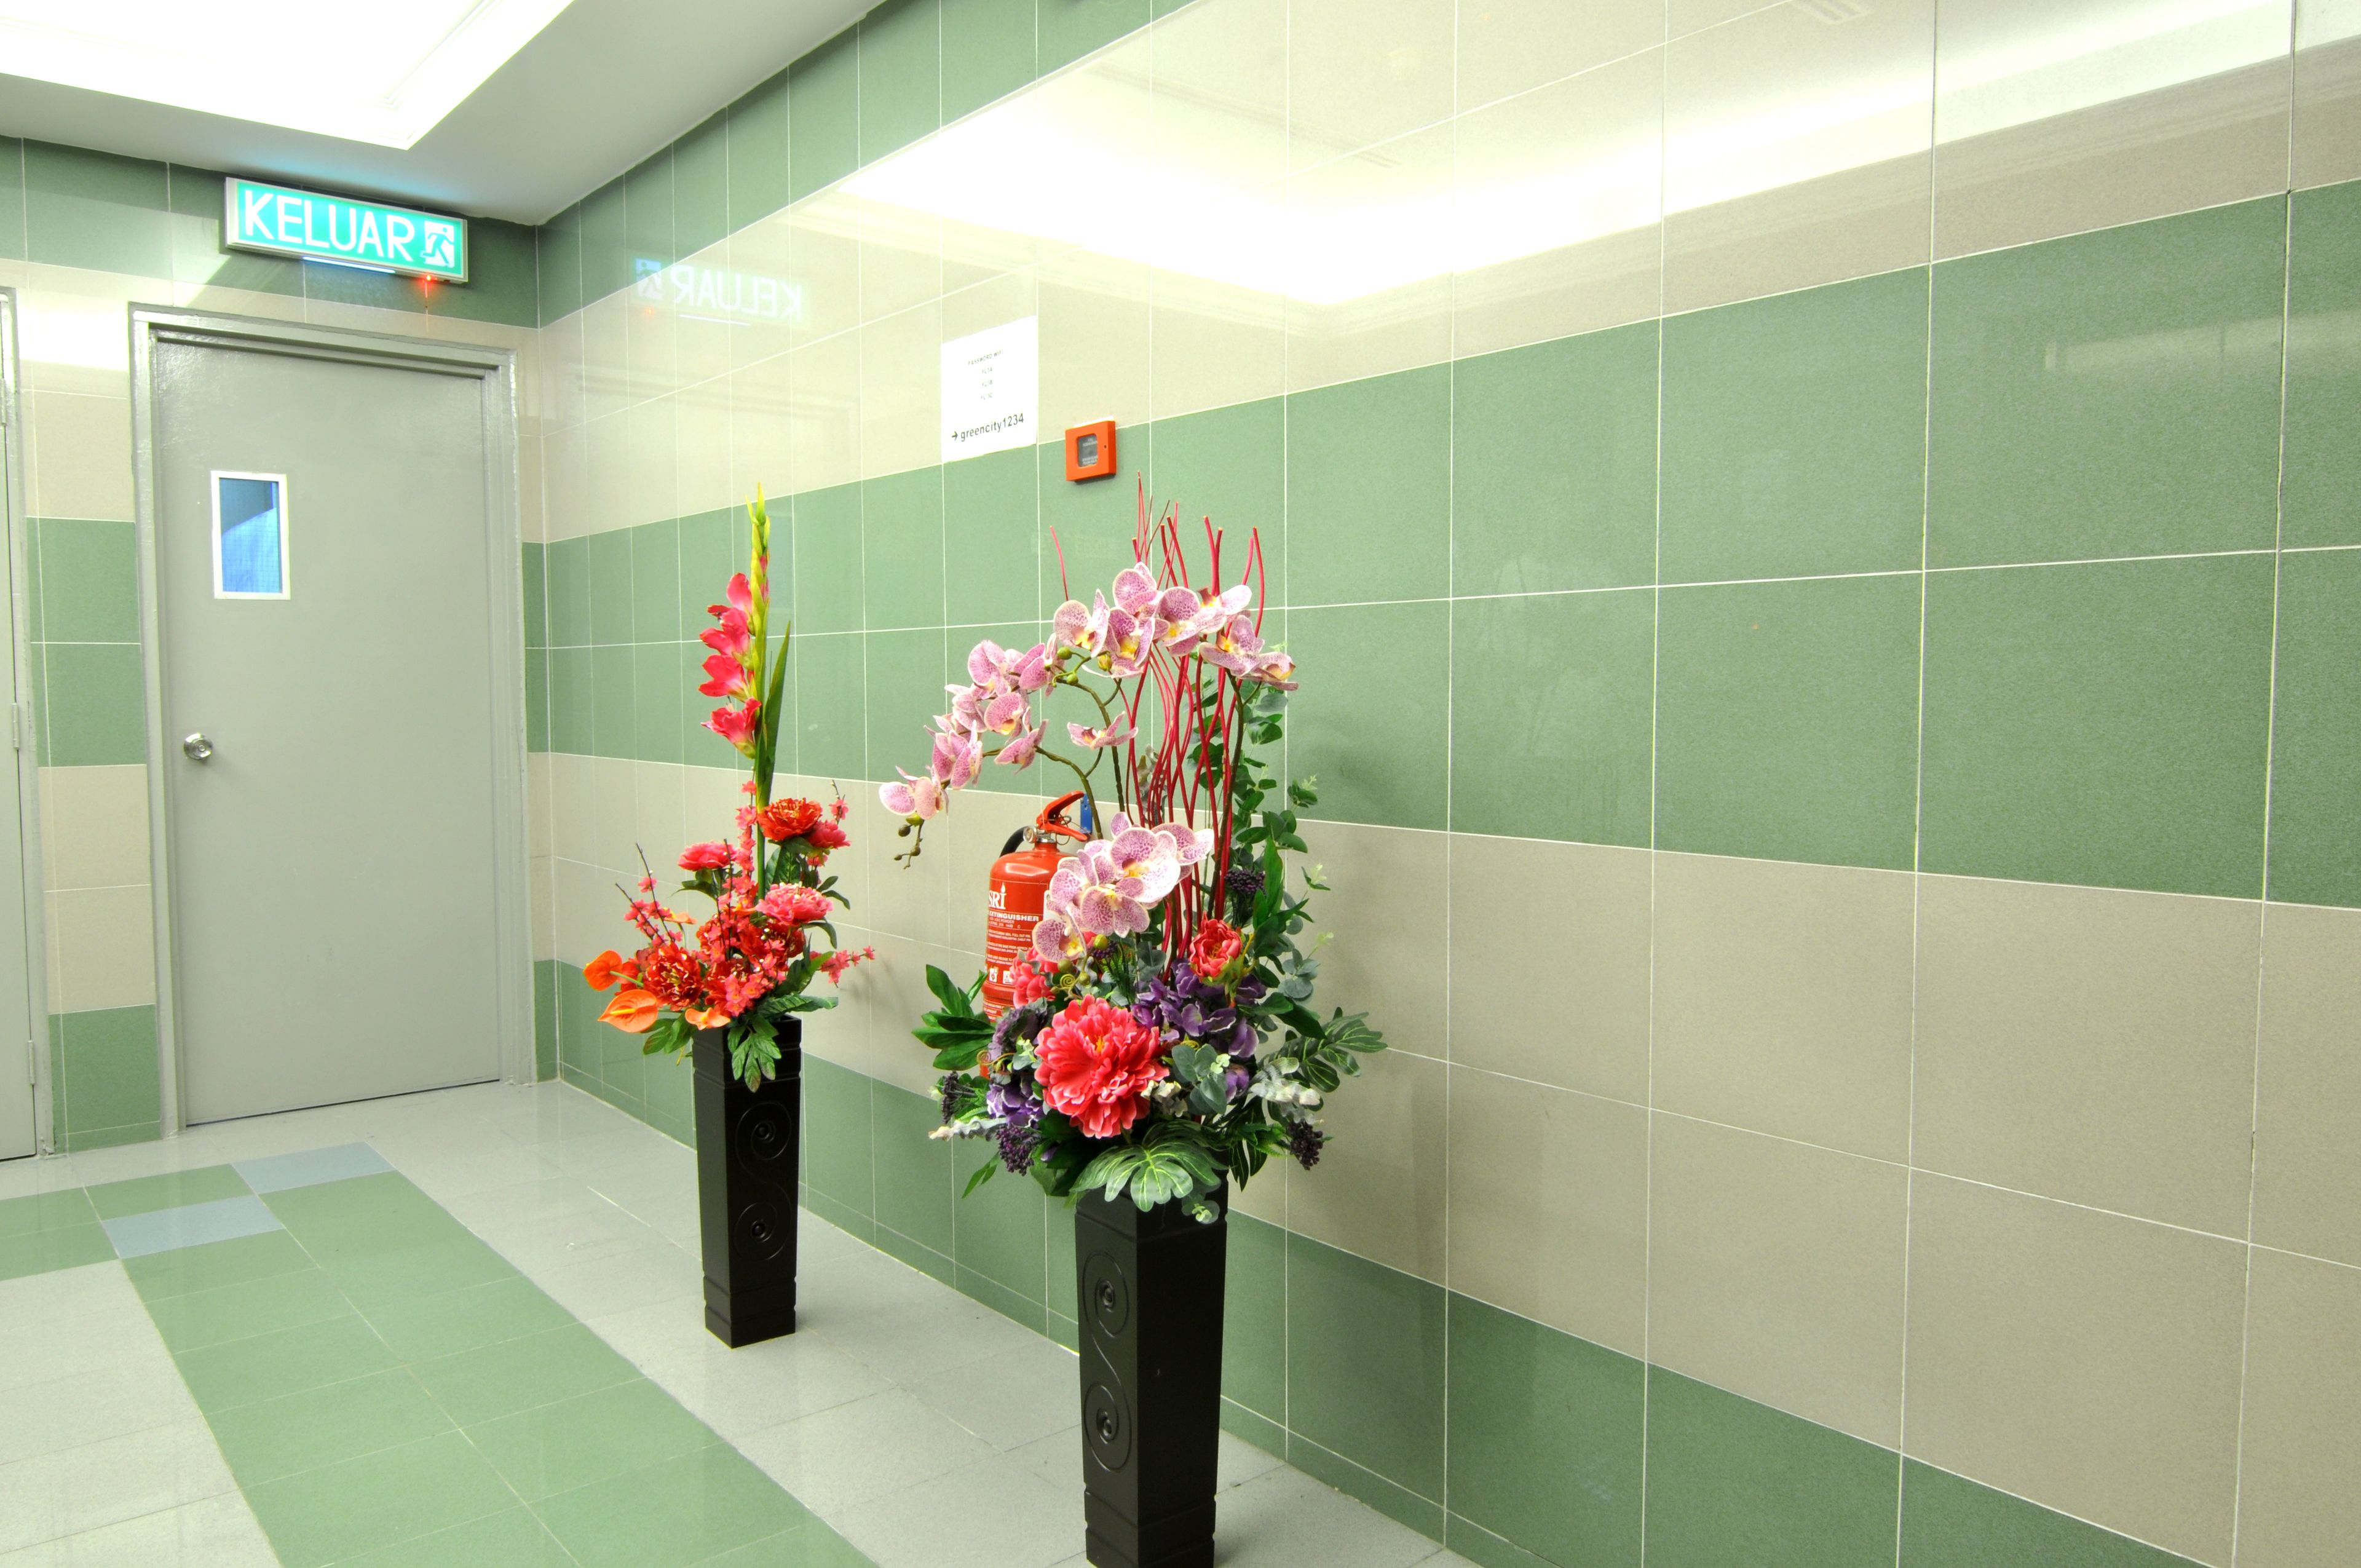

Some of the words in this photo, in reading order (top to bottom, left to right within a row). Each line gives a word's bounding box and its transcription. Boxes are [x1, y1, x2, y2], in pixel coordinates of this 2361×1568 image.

[245, 189, 416, 262] KELUAR
[968, 354, 992, 365] PASSWORD
[960, 413, 1024, 441] greencity1234
